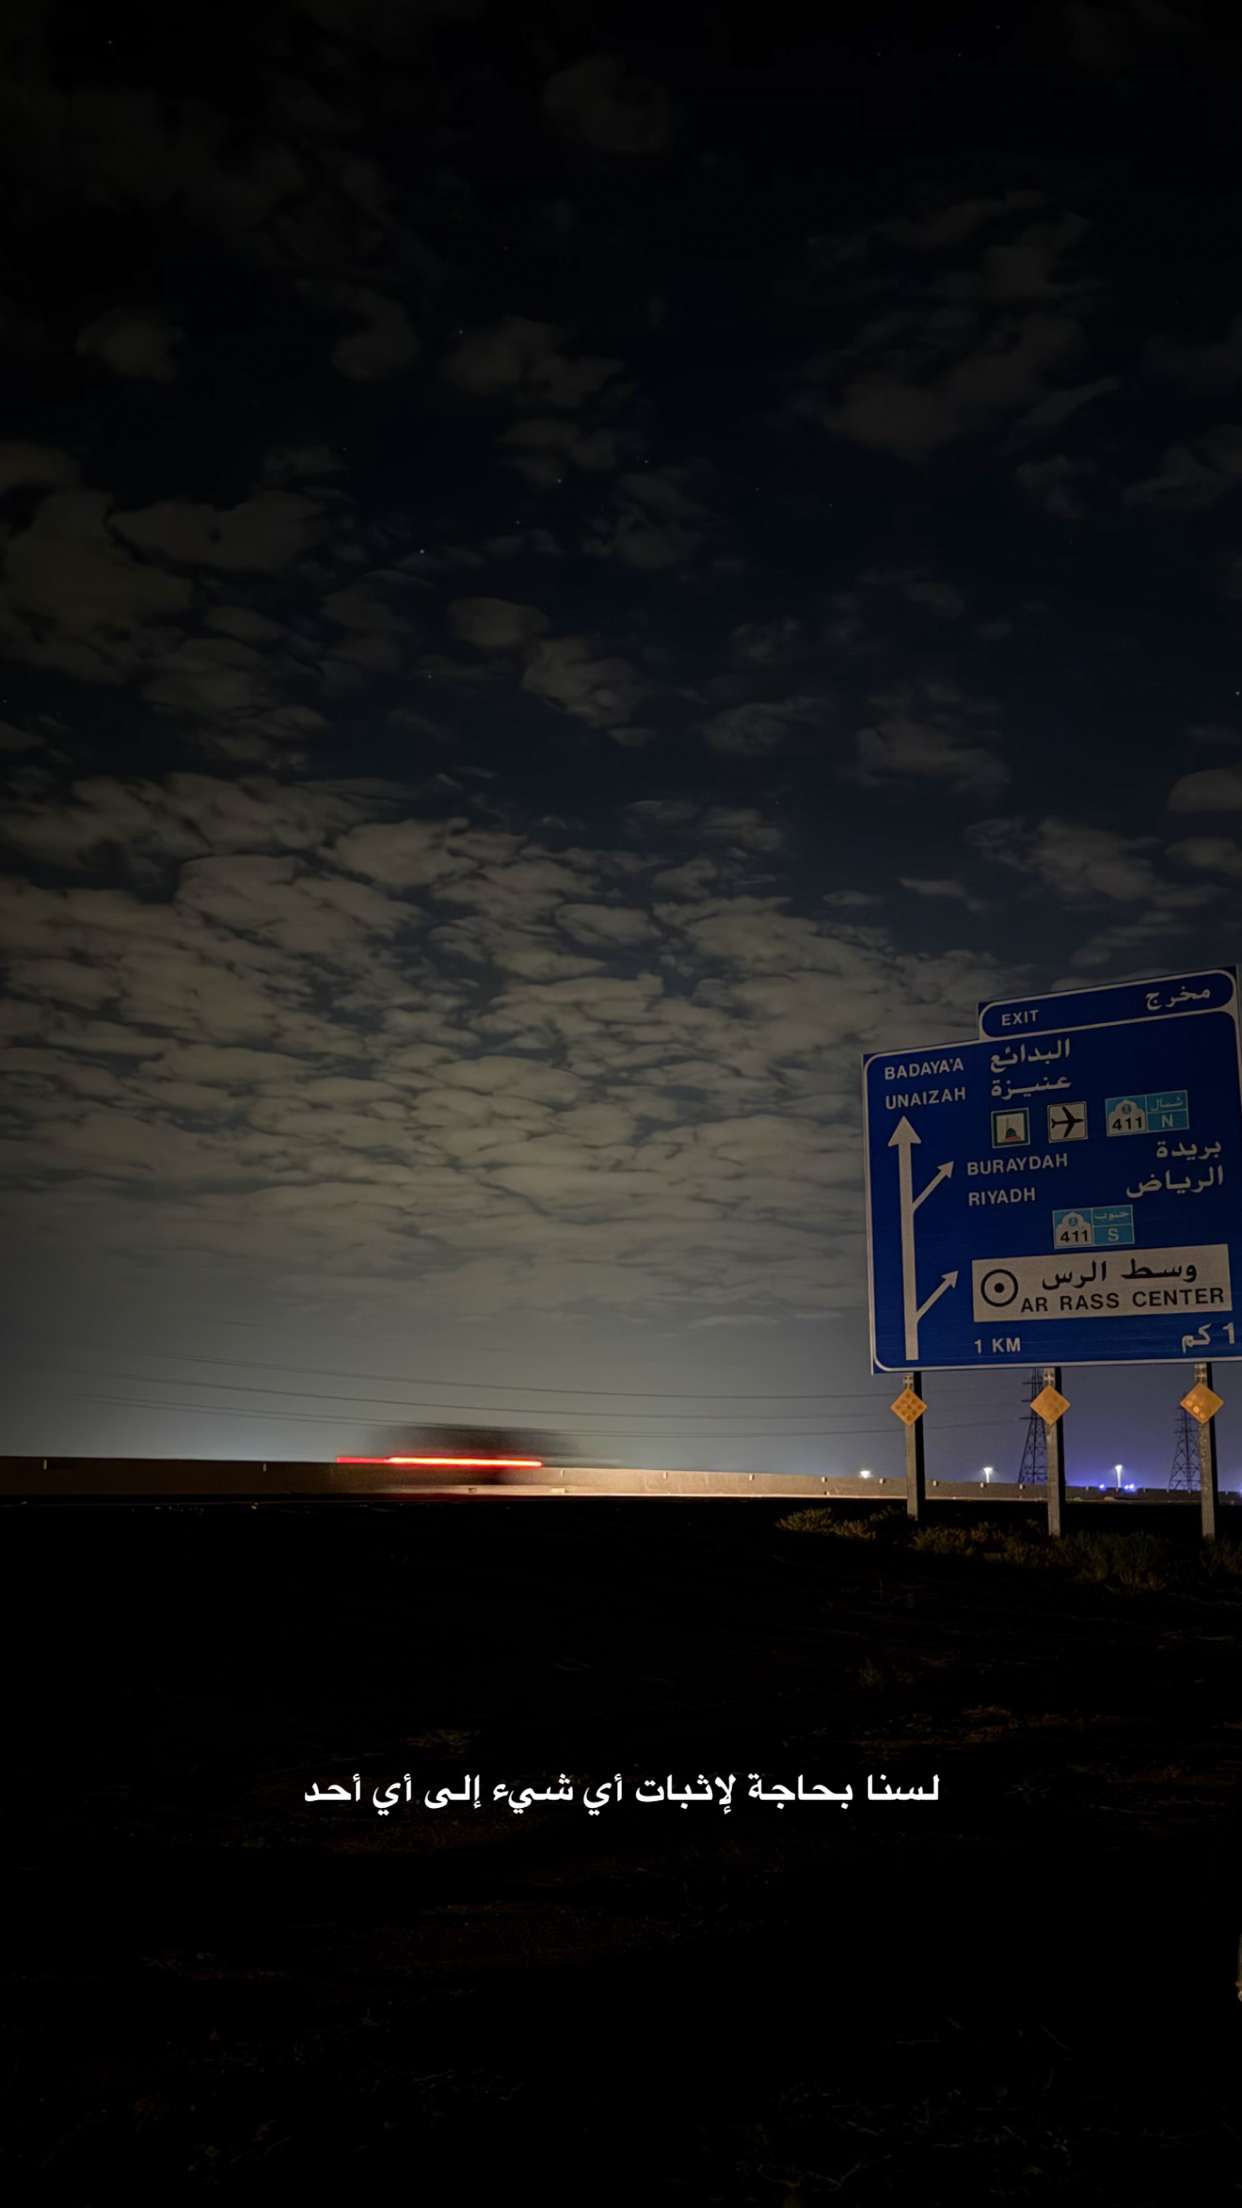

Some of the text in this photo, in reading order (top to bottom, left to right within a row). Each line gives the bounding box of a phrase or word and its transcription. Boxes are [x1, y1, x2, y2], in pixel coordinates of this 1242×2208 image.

[1144, 985, 1212, 1012] مخرج
[1000, 1009, 1040, 1027] EXIT
[989, 1037, 1072, 1074] البدائع
[883, 1057, 965, 1081] BADAYA'A
[885, 1087, 967, 1110] UNAIZAH
[990, 1074, 1072, 1101] عنيزة
[1111, 1117, 1143, 1131] 411
[1160, 1113, 1174, 1129] N
[1155, 1138, 1223, 1161] بريدة
[966, 1152, 1069, 1177] BURAYDAH
[1125, 1164, 1225, 1199] الرياض
[967, 1186, 1037, 1207] RIYADH
[1060, 1229, 1088, 1242] 411
[1107, 1227, 1120, 1242] S
[1041, 1258, 1198, 1290] وسط الرس
[1020, 1287, 1225, 1313] AR RASS CENTER
[973, 1336, 1022, 1355] 1 KM
[1180, 1322, 1237, 1354] 1 كم
